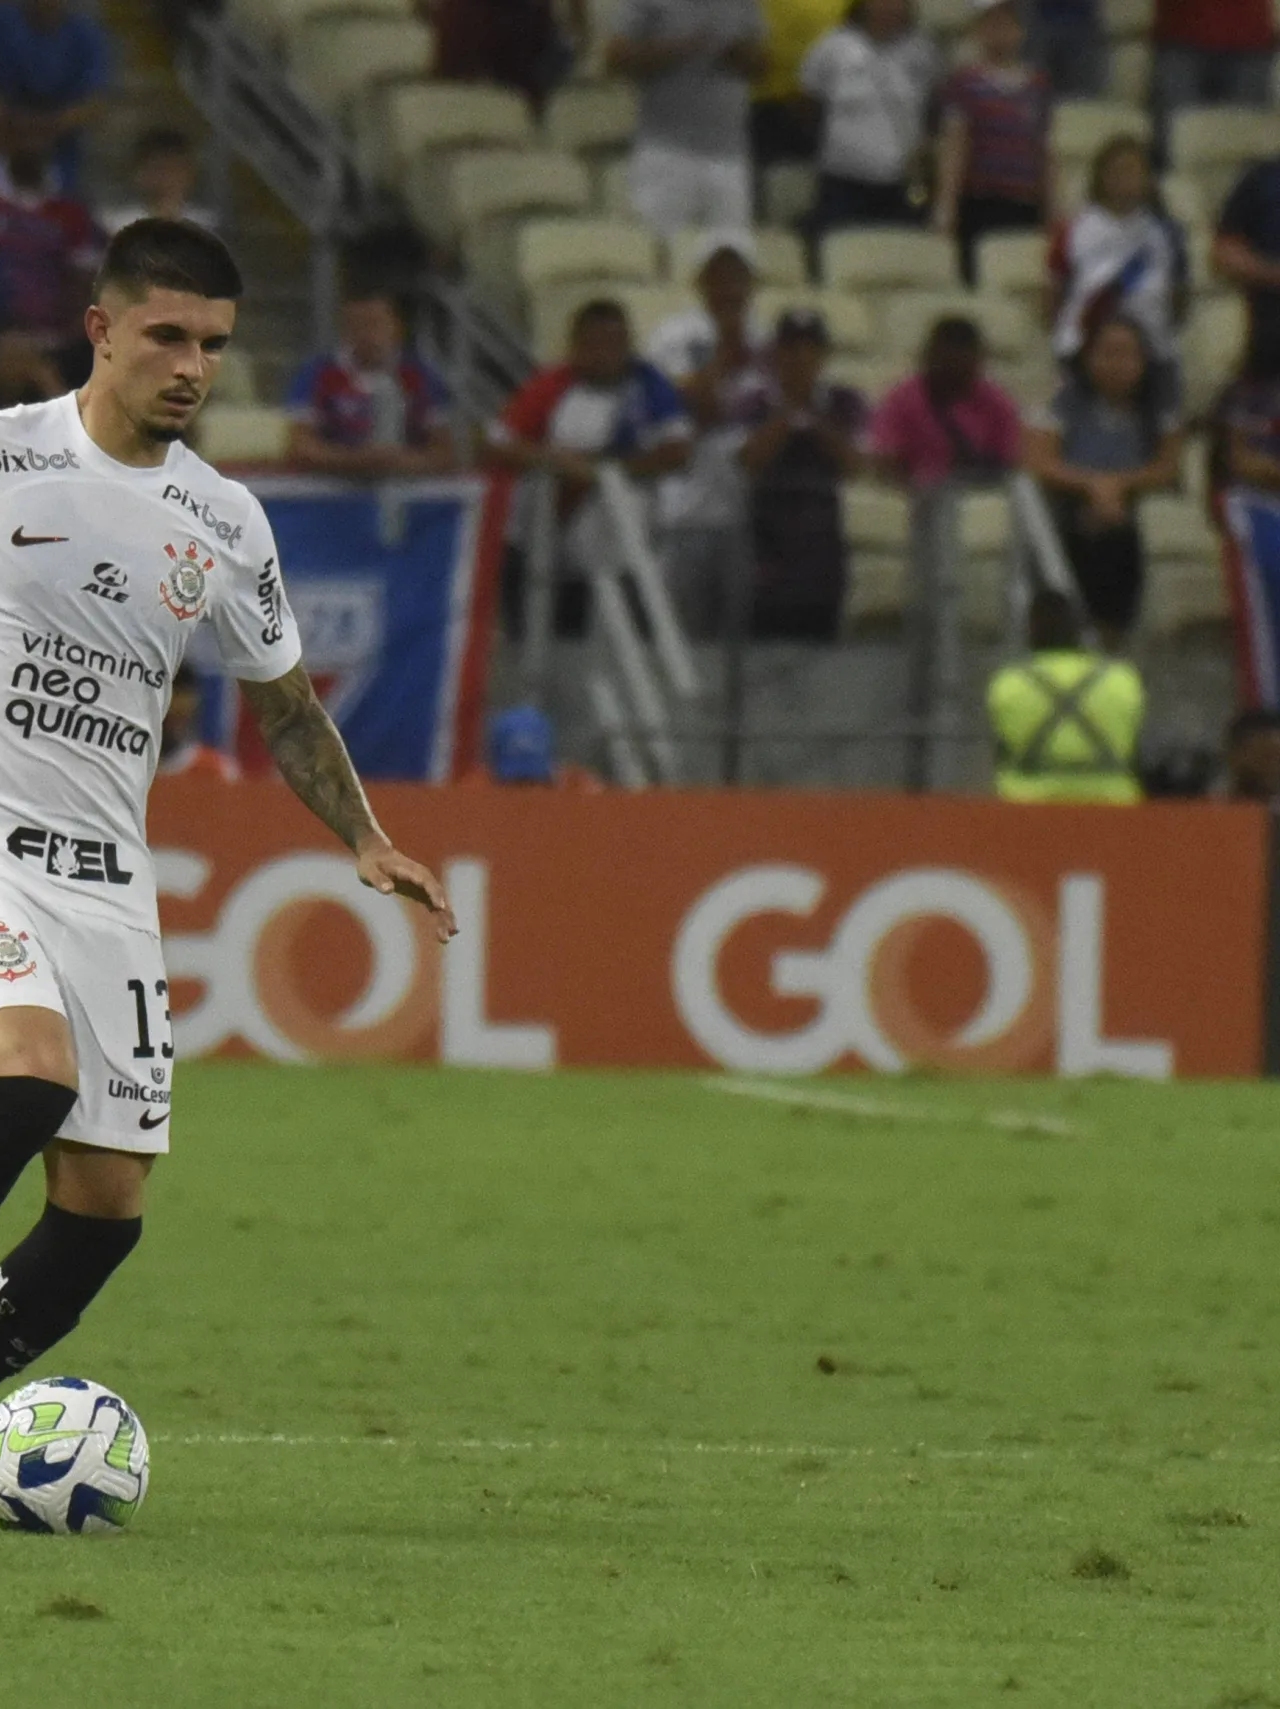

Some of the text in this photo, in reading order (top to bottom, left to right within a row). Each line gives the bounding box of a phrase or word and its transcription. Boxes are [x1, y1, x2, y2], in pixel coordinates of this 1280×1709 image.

[161, 483, 244, 550] pixbet
[80, 582, 131, 604] ALE
[256, 575, 284, 647] bmg
[11, 662, 101, 705] neo
[5, 699, 150, 757] química
[671, 861, 1174, 1082] GOL
